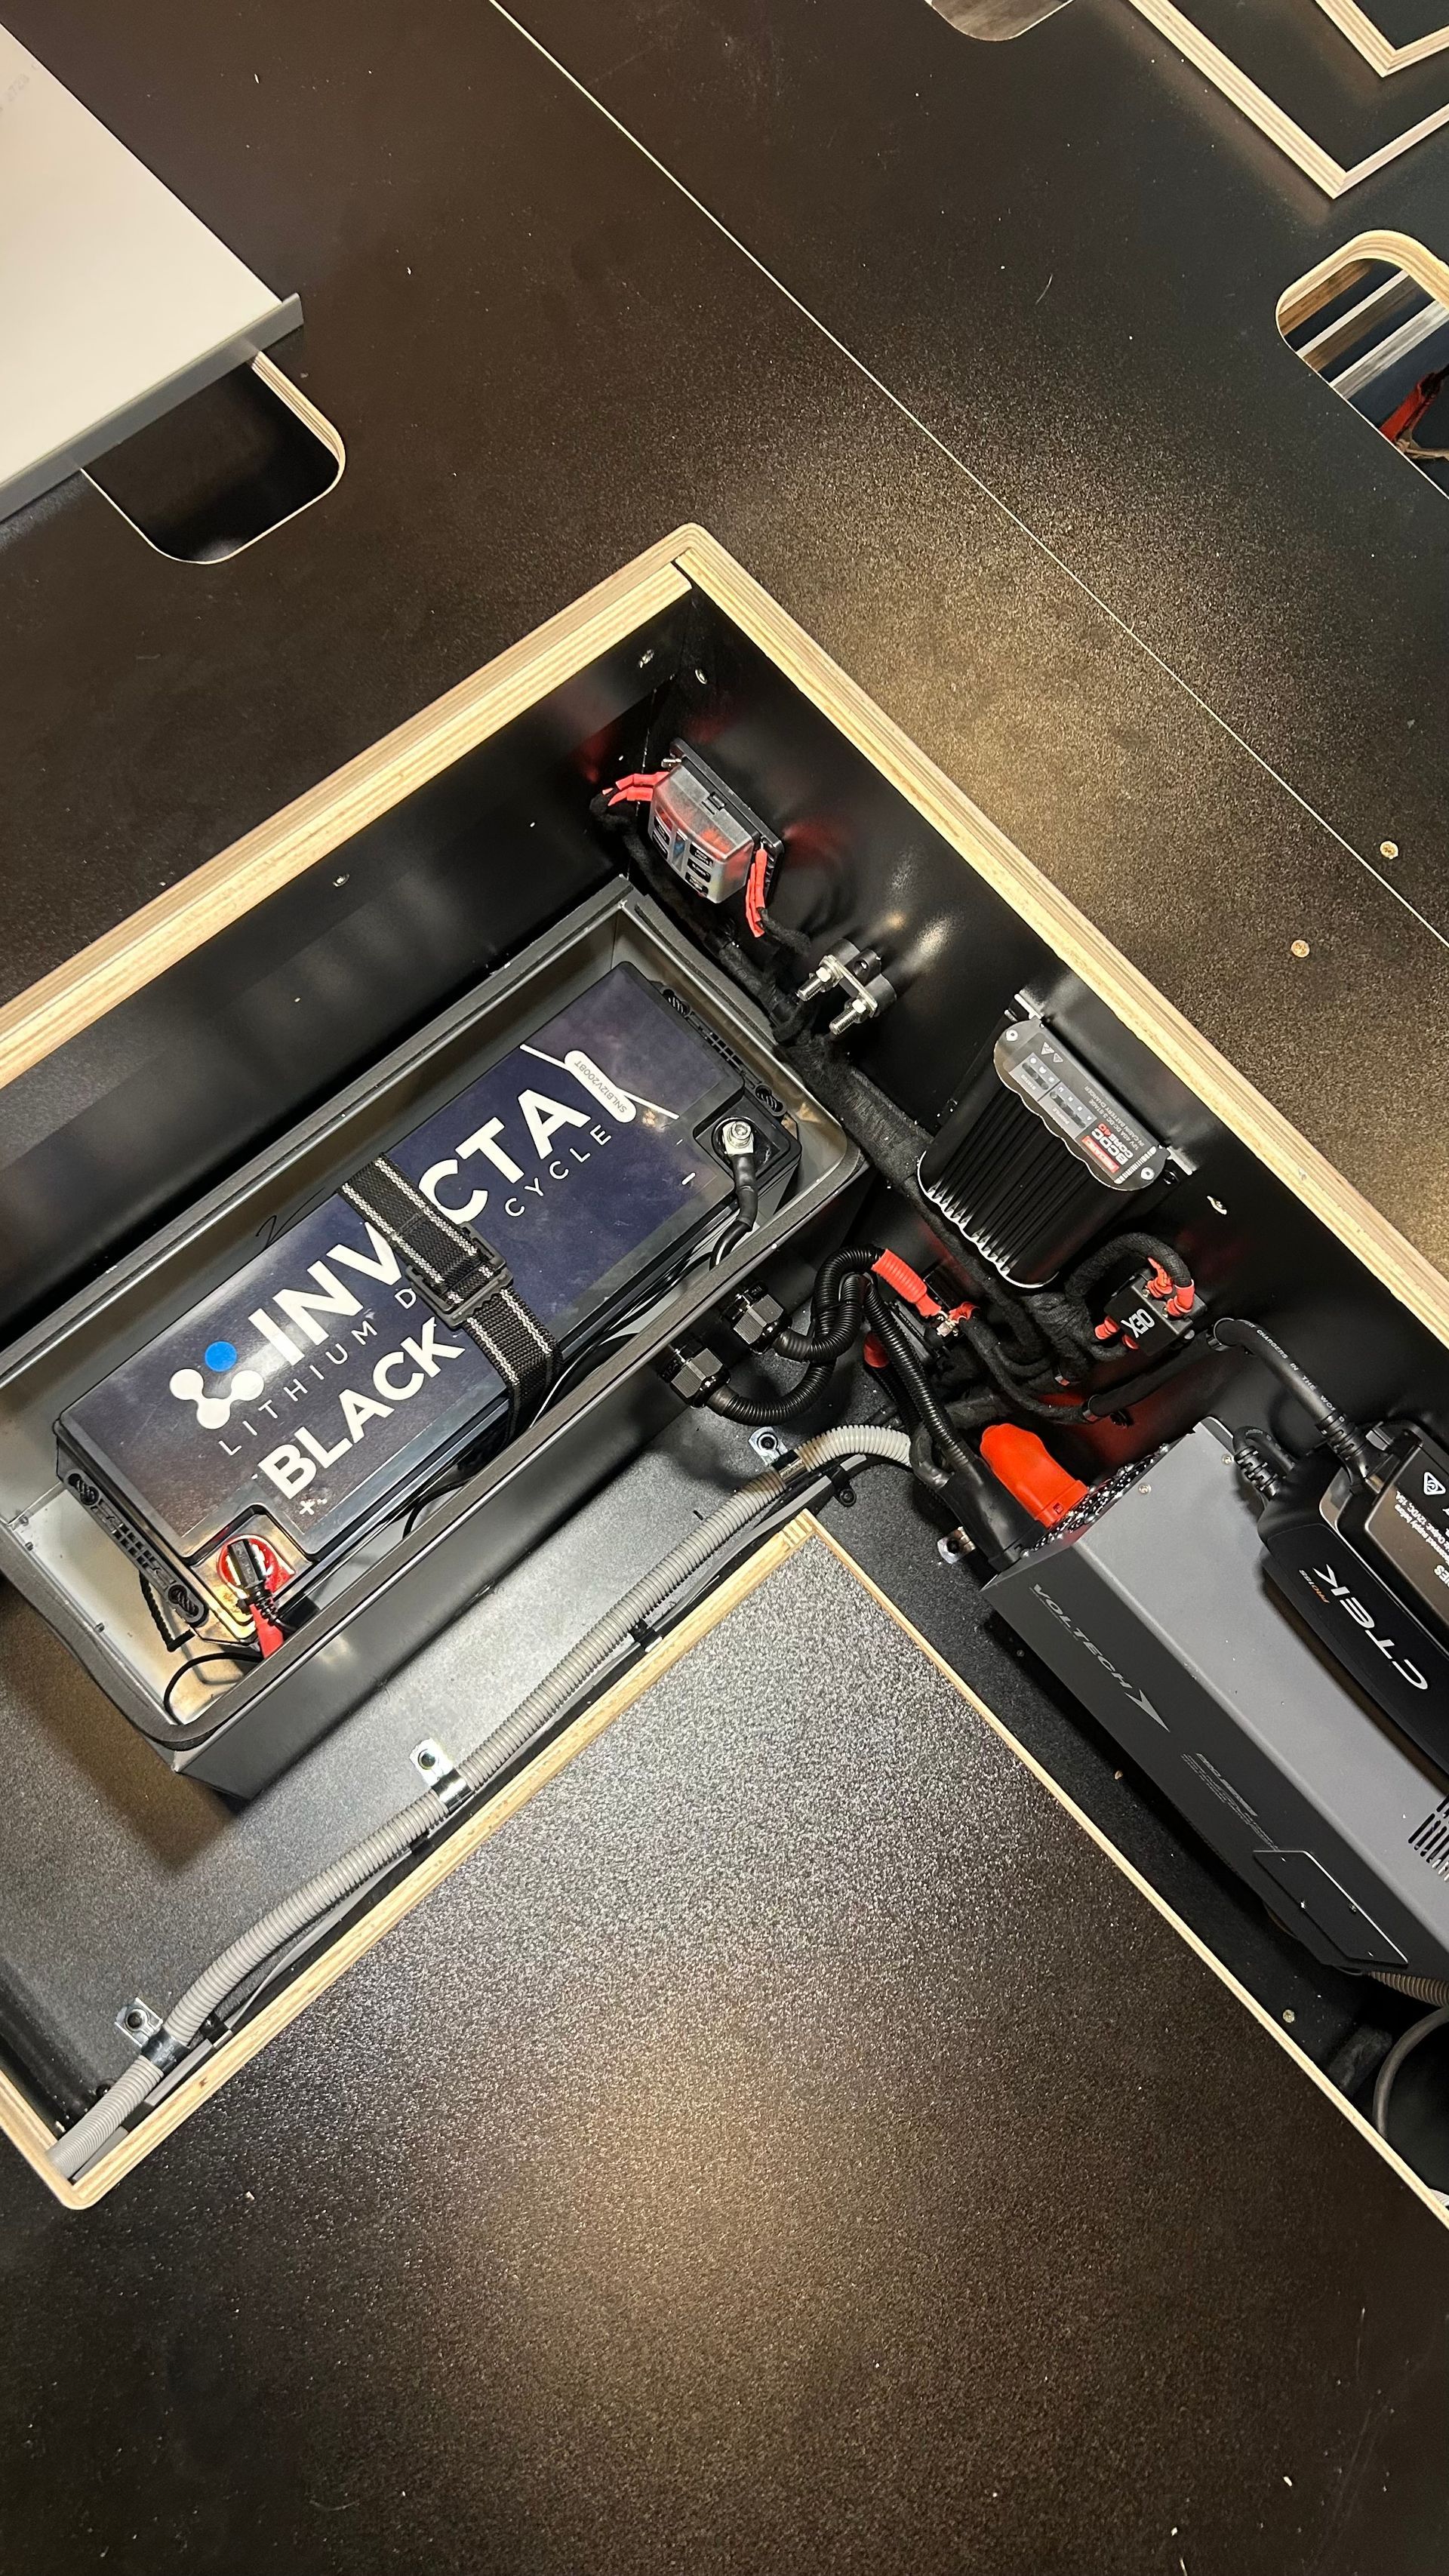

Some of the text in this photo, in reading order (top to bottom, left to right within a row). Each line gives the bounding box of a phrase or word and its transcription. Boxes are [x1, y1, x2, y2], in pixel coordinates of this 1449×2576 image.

[1084, 1086, 1106, 1108] CHARGER
[1105, 1106, 1126, 1128] BATTERY
[504, 1124, 612, 1217] CYCLE
[1091, 1128, 1129, 1165] BCDC
[248, 1089, 591, 1365] INVCTA
[1121, 1309, 1155, 1339] OEX
[219, 1320, 377, 1456] LITHIUM
[1257, 1329, 1288, 1359] CHARGERS
[1290, 1362, 1299, 1371] IN
[1302, 1375, 1316, 1390] THE
[257, 1317, 465, 1500] BLACK
[1394, 1503, 1413, 1523] before
[1410, 1519, 1429, 1539] supply
[1033, 1583, 1133, 1688] VOLTECH
[1312, 1563, 1429, 1690] CTEK
